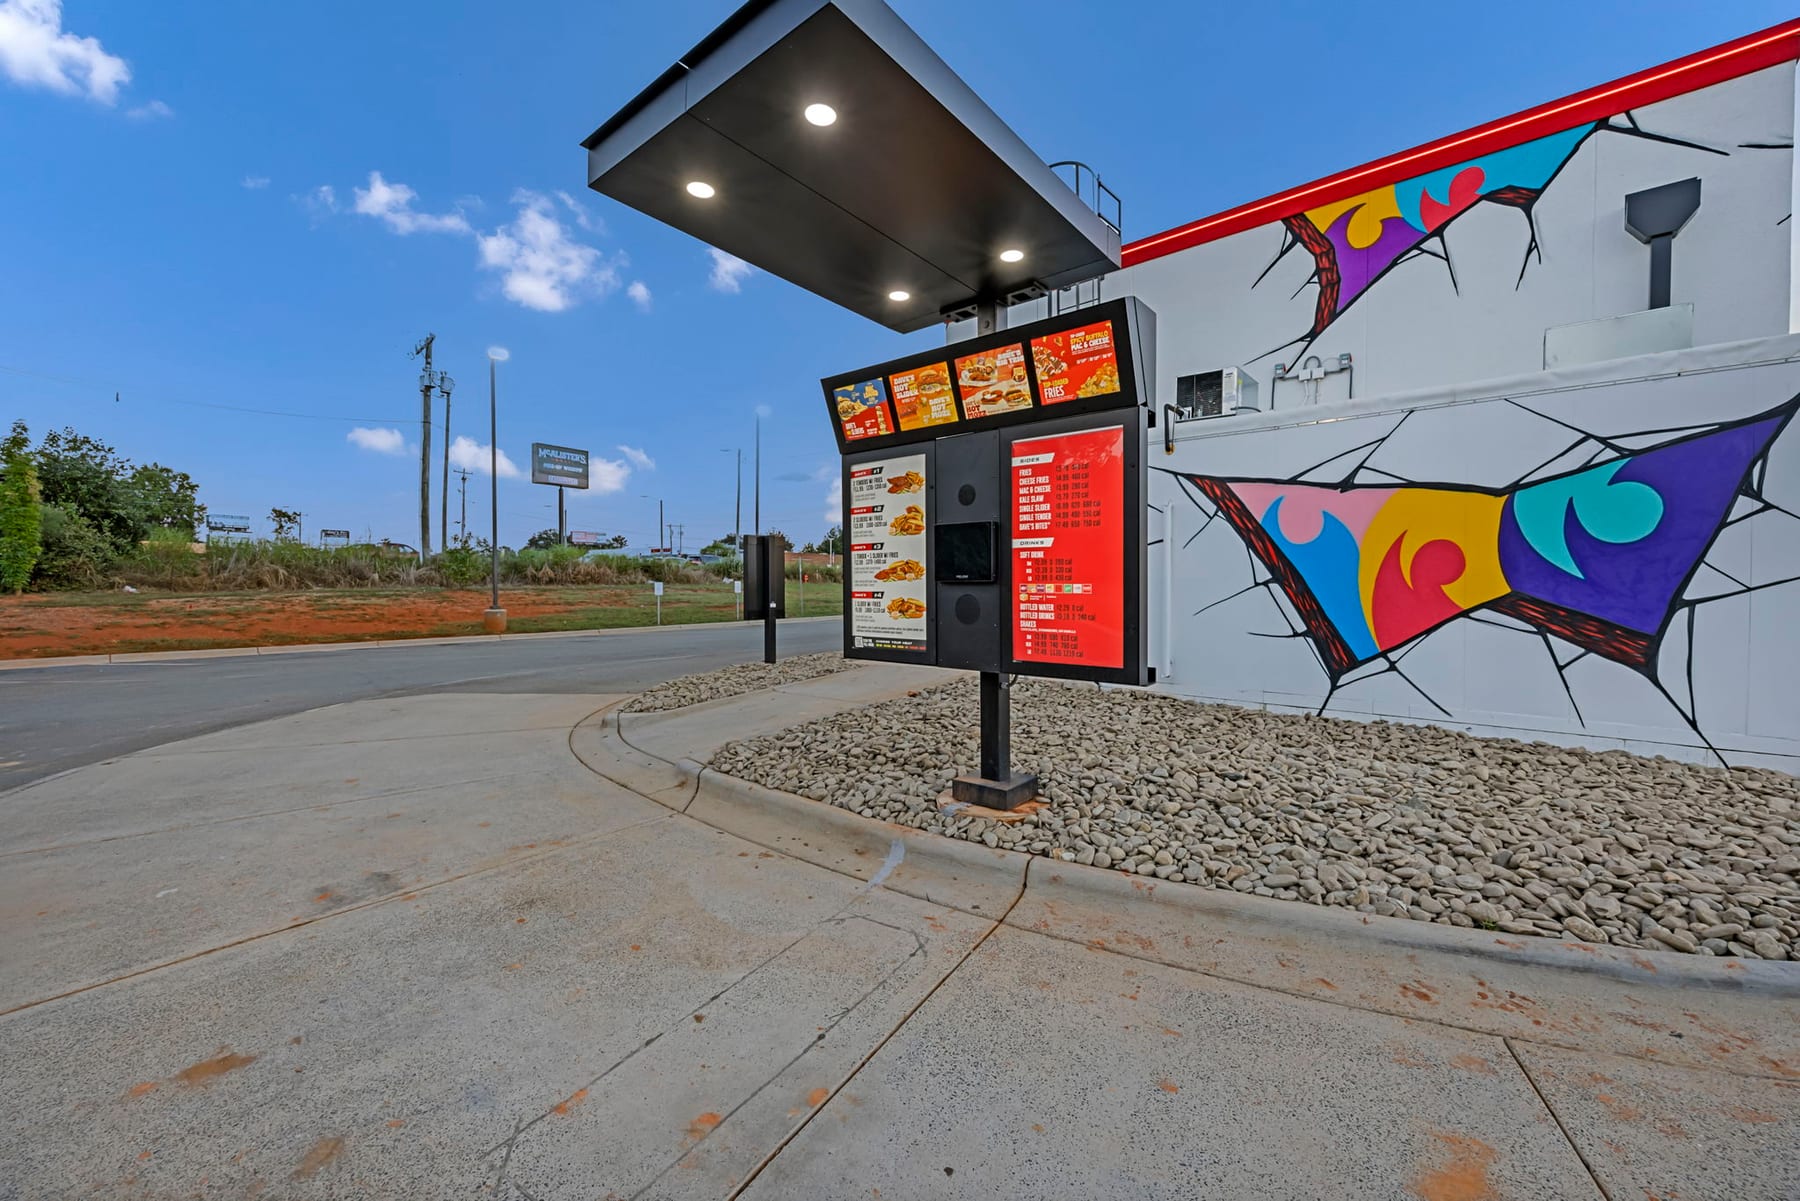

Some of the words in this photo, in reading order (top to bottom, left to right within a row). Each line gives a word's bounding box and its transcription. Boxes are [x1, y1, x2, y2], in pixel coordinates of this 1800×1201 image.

[1070, 336, 1084, 345] SPICY
[1086, 330, 1108, 341] BUFFALO
[1071, 343, 1083, 352] MAC
[1088, 336, 1110, 346] CHEESE
[894, 383, 908, 392] HOT
[1044, 386, 1064, 398] FRIES
[932, 404, 946, 412] HOT
[1019, 468, 1032, 476] FRIES
[1019, 477, 1036, 486] CHEESE
[1036, 476, 1050, 484] FRIES
[1019, 486, 1030, 494] MAC
[1034, 484, 1052, 493] CHEESE
[1019, 496, 1030, 504] KALE
[1030, 494, 1044, 502] SLAW
[1019, 504, 1034, 512] SINGLE
[1034, 503, 1050, 511] SLIDER
[1019, 513, 1034, 522] SINGLE
[1034, 512, 1052, 521] TENDER
[1019, 522, 1034, 530] DAVE'S
